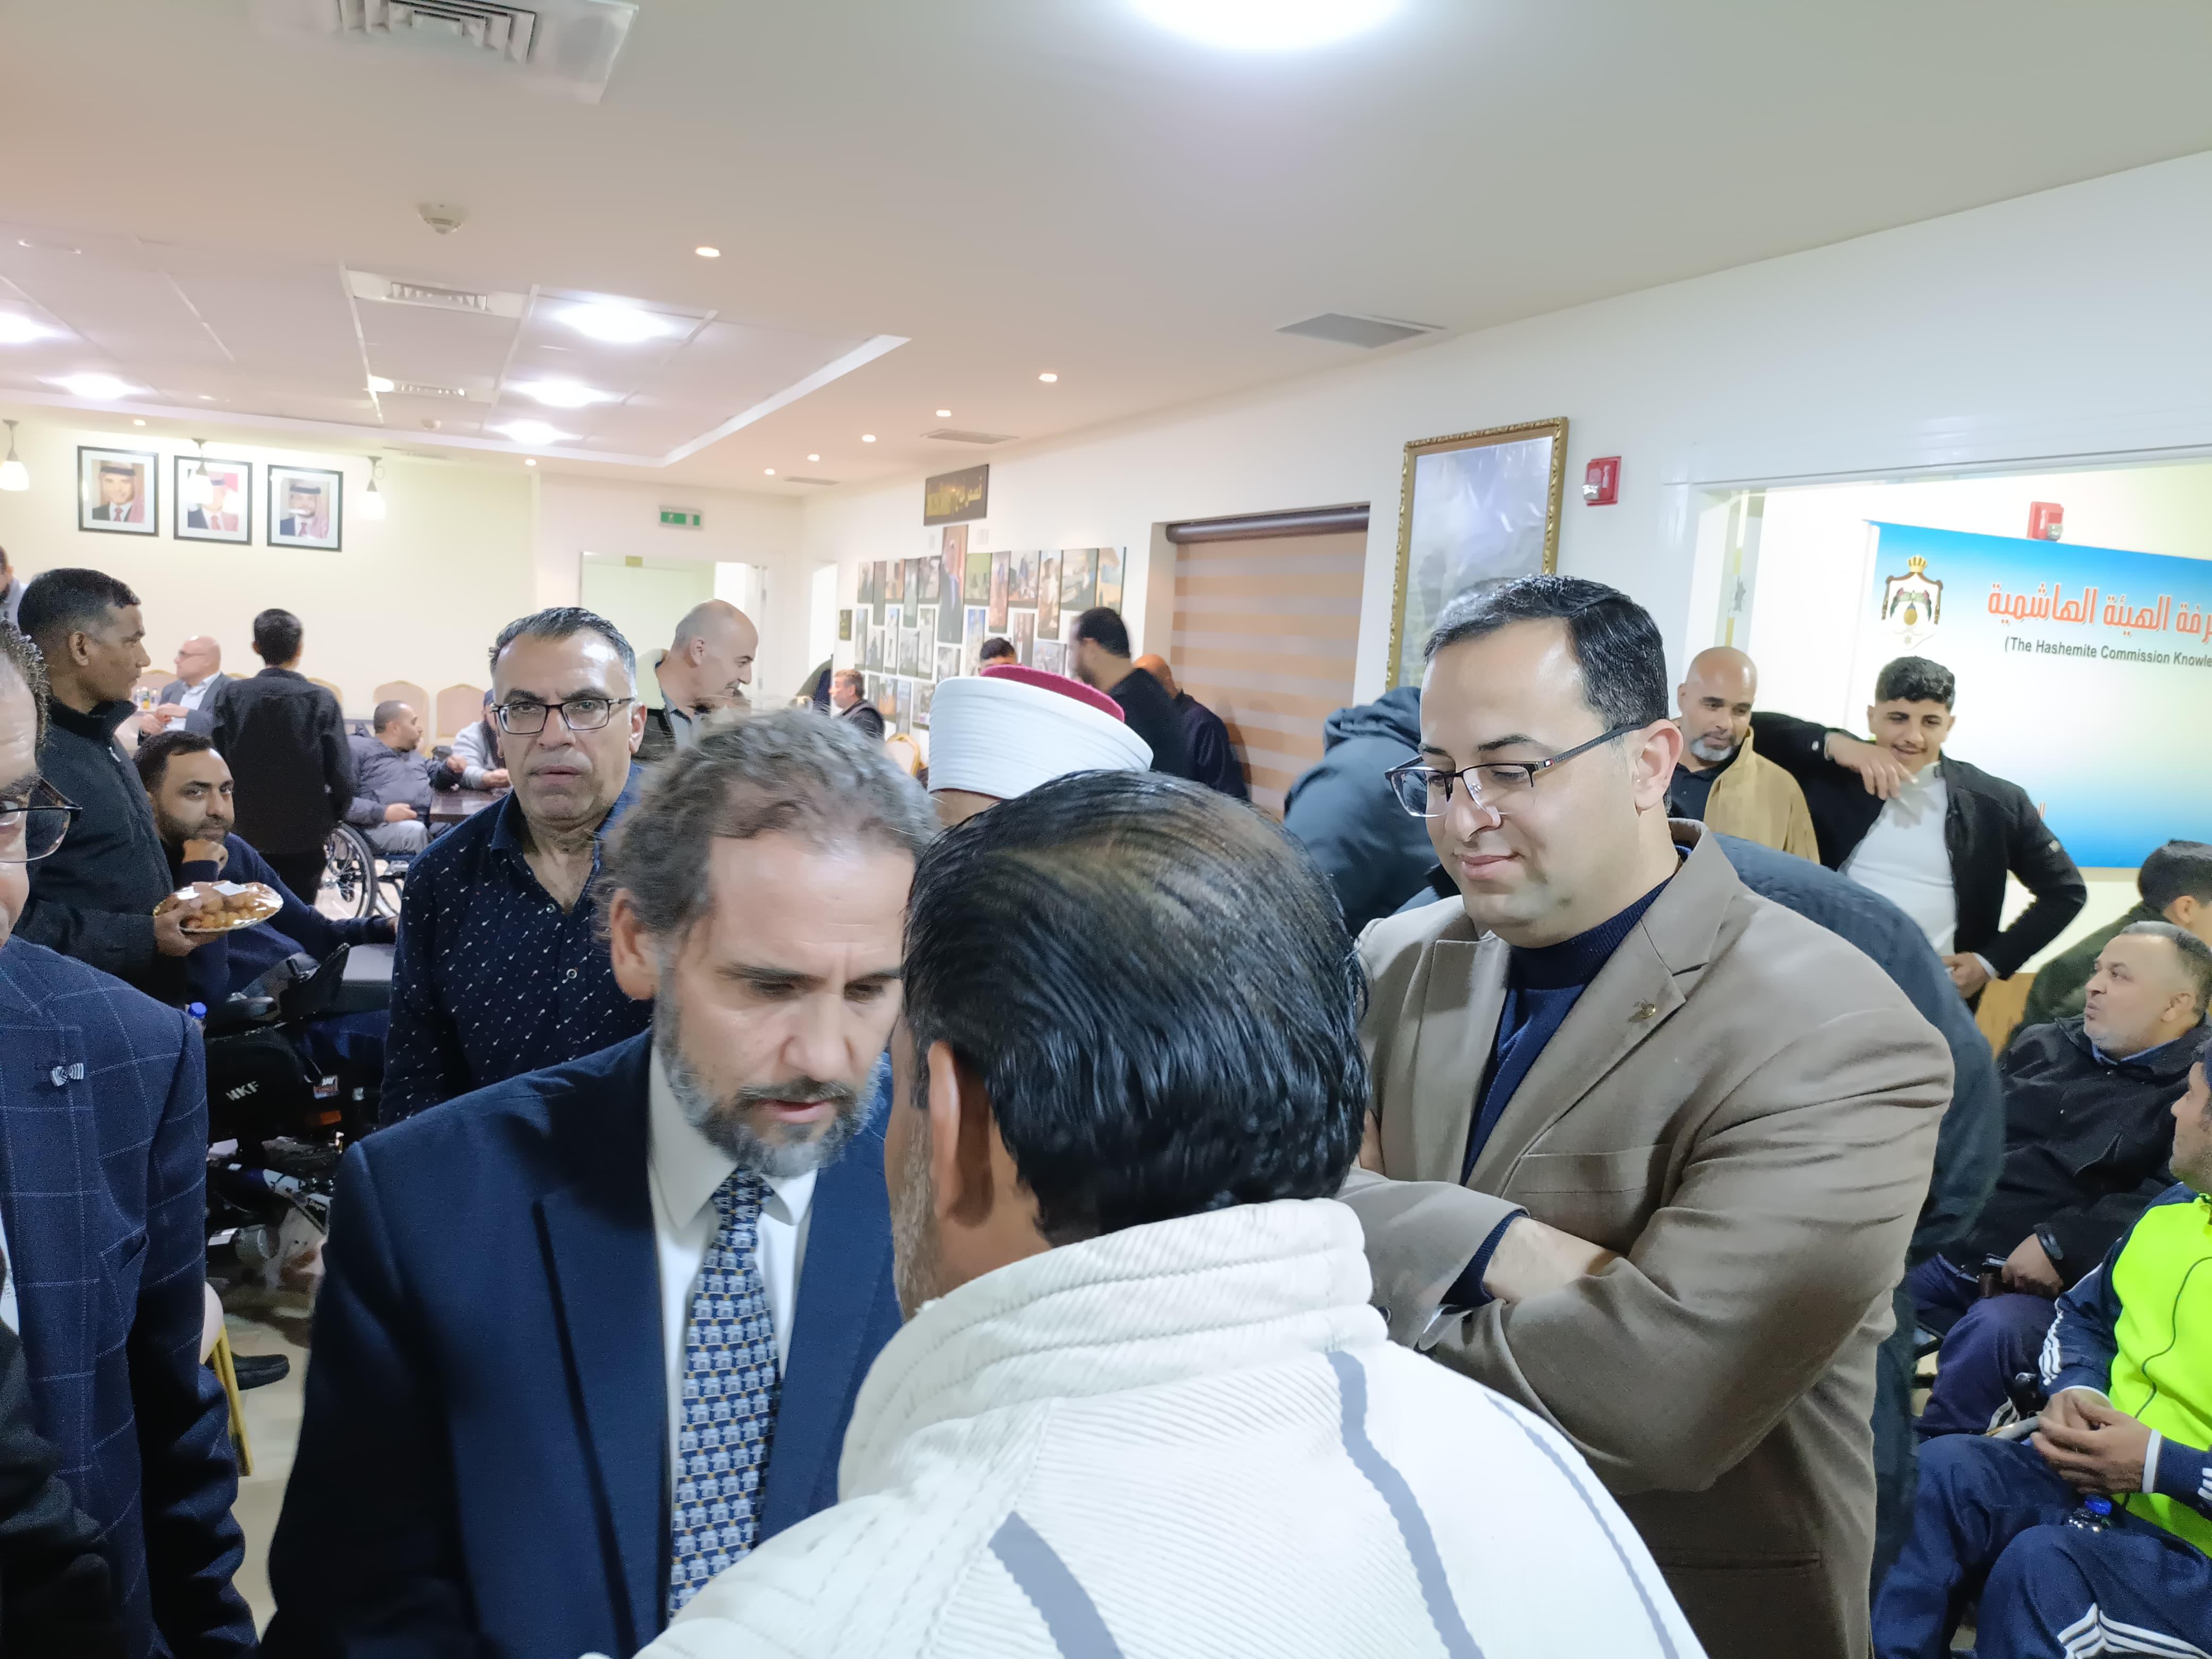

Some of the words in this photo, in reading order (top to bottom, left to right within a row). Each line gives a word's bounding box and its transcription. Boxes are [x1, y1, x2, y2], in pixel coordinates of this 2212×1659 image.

[1988, 583, 2098, 624] الهاشمية
[2104, 595, 2171, 636] الهيئة
[2176, 603, 2212, 643] رفة
[2005, 636, 2032, 652] (The
[2036, 640, 2097, 658] Hashemite
[2101, 645, 2170, 664] Commission
